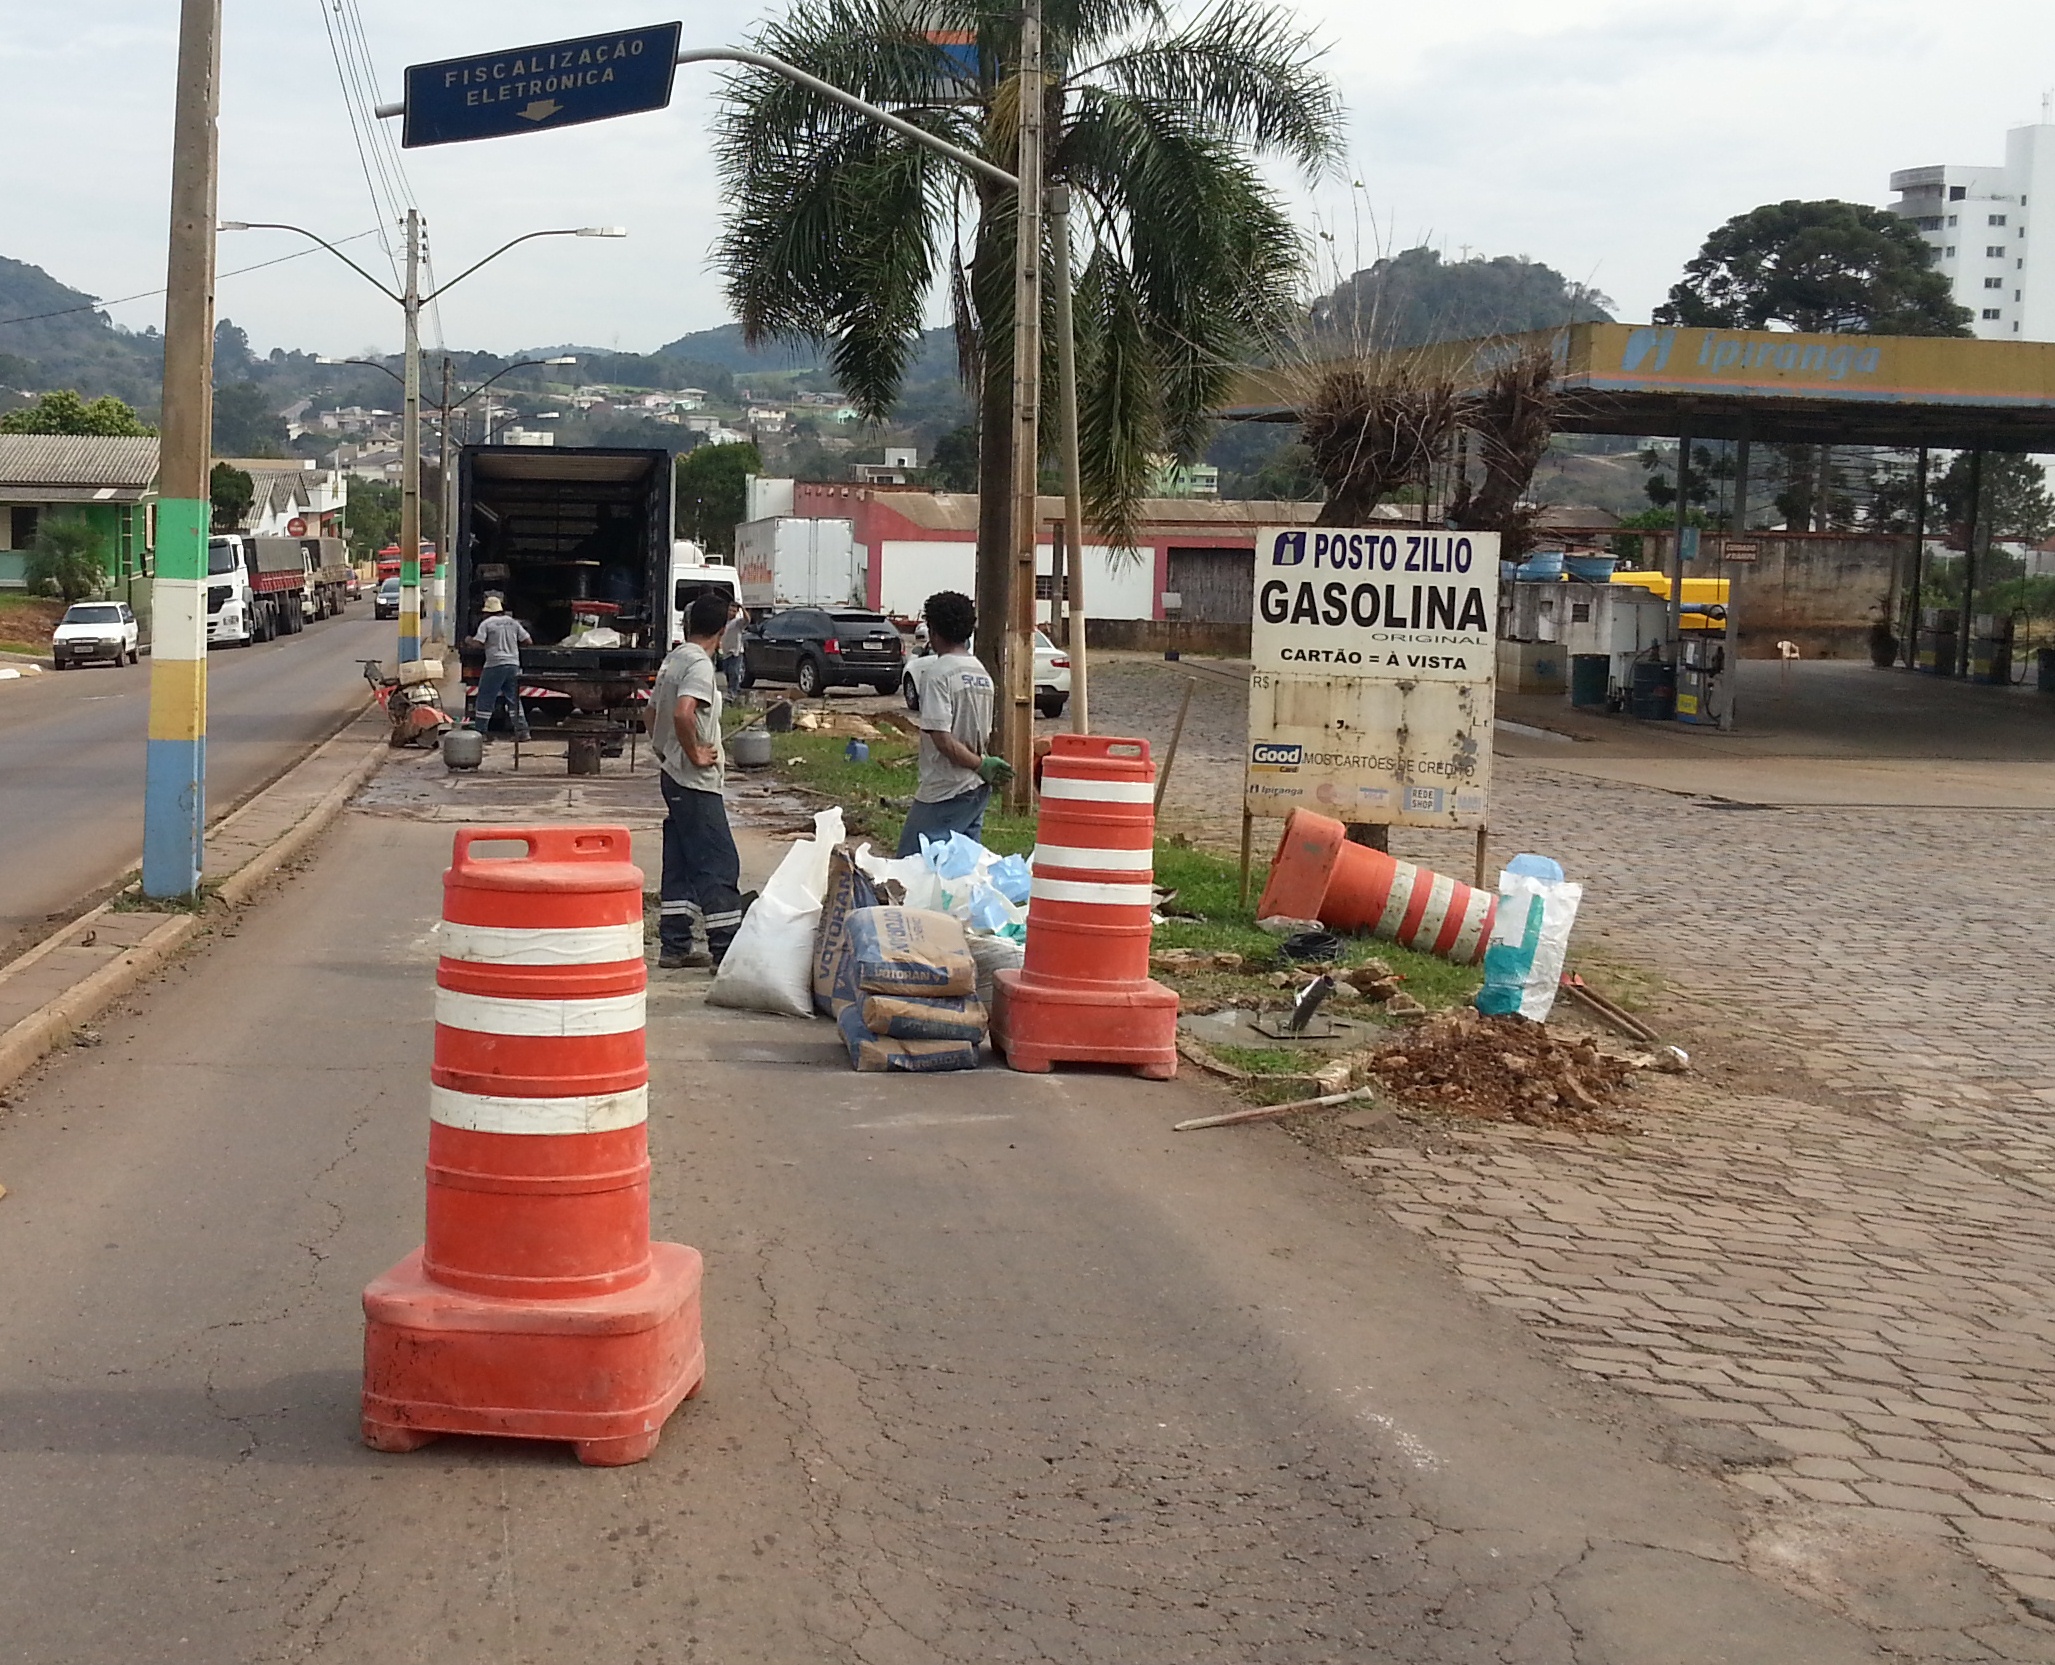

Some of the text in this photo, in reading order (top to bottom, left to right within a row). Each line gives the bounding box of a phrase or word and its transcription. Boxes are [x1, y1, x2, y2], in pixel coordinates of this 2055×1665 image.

[445, 39, 645, 88] FISCALIZAÇÃO
[1314, 533, 1473, 573] POSTO ZILIO
[1260, 579, 1489, 632] GASOLINA
[1371, 632, 1488, 646] ORIGINAL
[1280, 648, 1363, 665] CARTÃO
[1407, 654, 1467, 670] VISTA
[1253, 675, 1270, 689] R$
[1254, 747, 1300, 763] Good
[1279, 765, 1298, 773] Card
[1412, 789, 1434, 800] REDE
[1411, 799, 1434, 810] SHOP
[819, 871, 851, 979] VOTORAN
